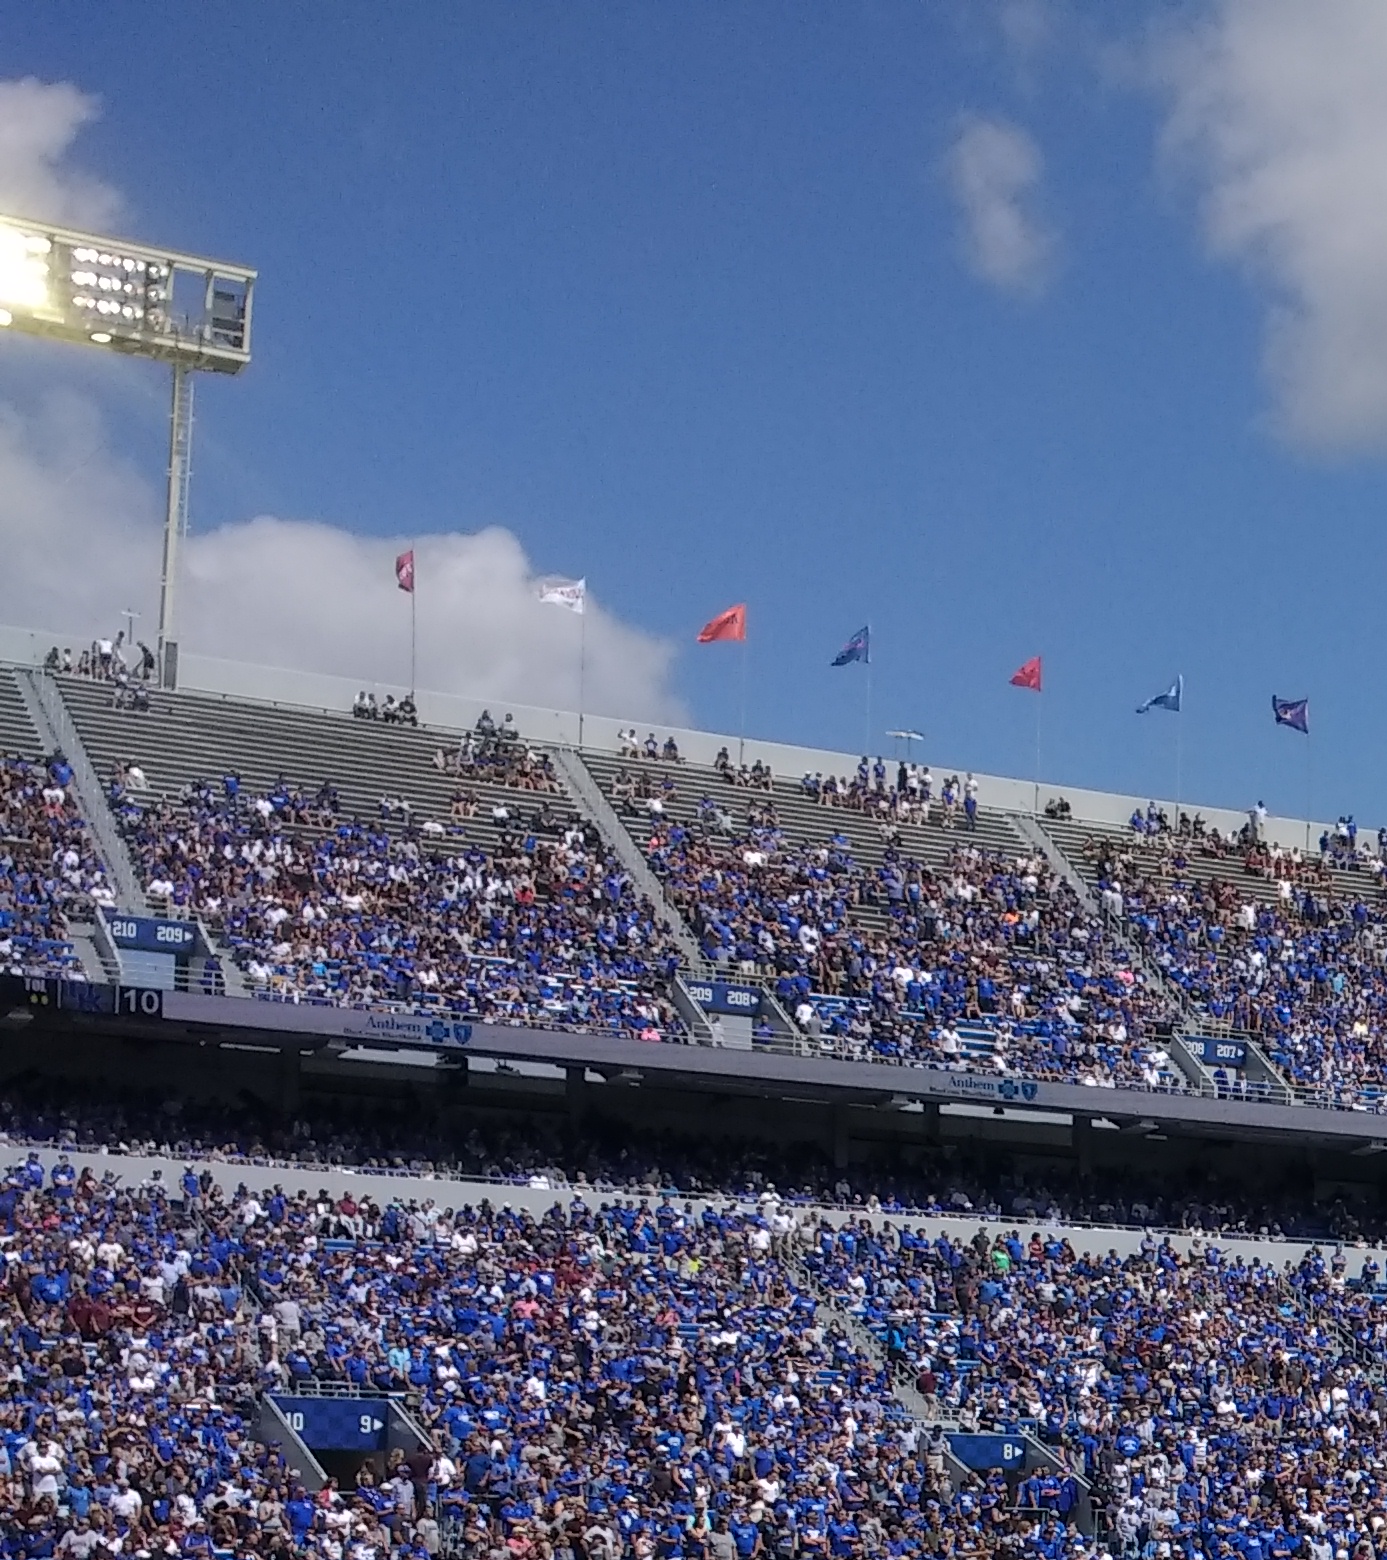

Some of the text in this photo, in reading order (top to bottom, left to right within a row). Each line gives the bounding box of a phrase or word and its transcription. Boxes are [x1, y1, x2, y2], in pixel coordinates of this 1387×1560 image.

[113, 921, 183, 942] 210 209
[124, 990, 160, 1014] 10
[690, 986, 751, 1006] 209 208
[366, 1015, 421, 1033] Anthem
[1217, 1045, 1236, 1059] 207
[949, 1076, 995, 1091] Anthem
[360, 1415, 372, 1434] 9
[1003, 1443, 1013, 1460] 8
